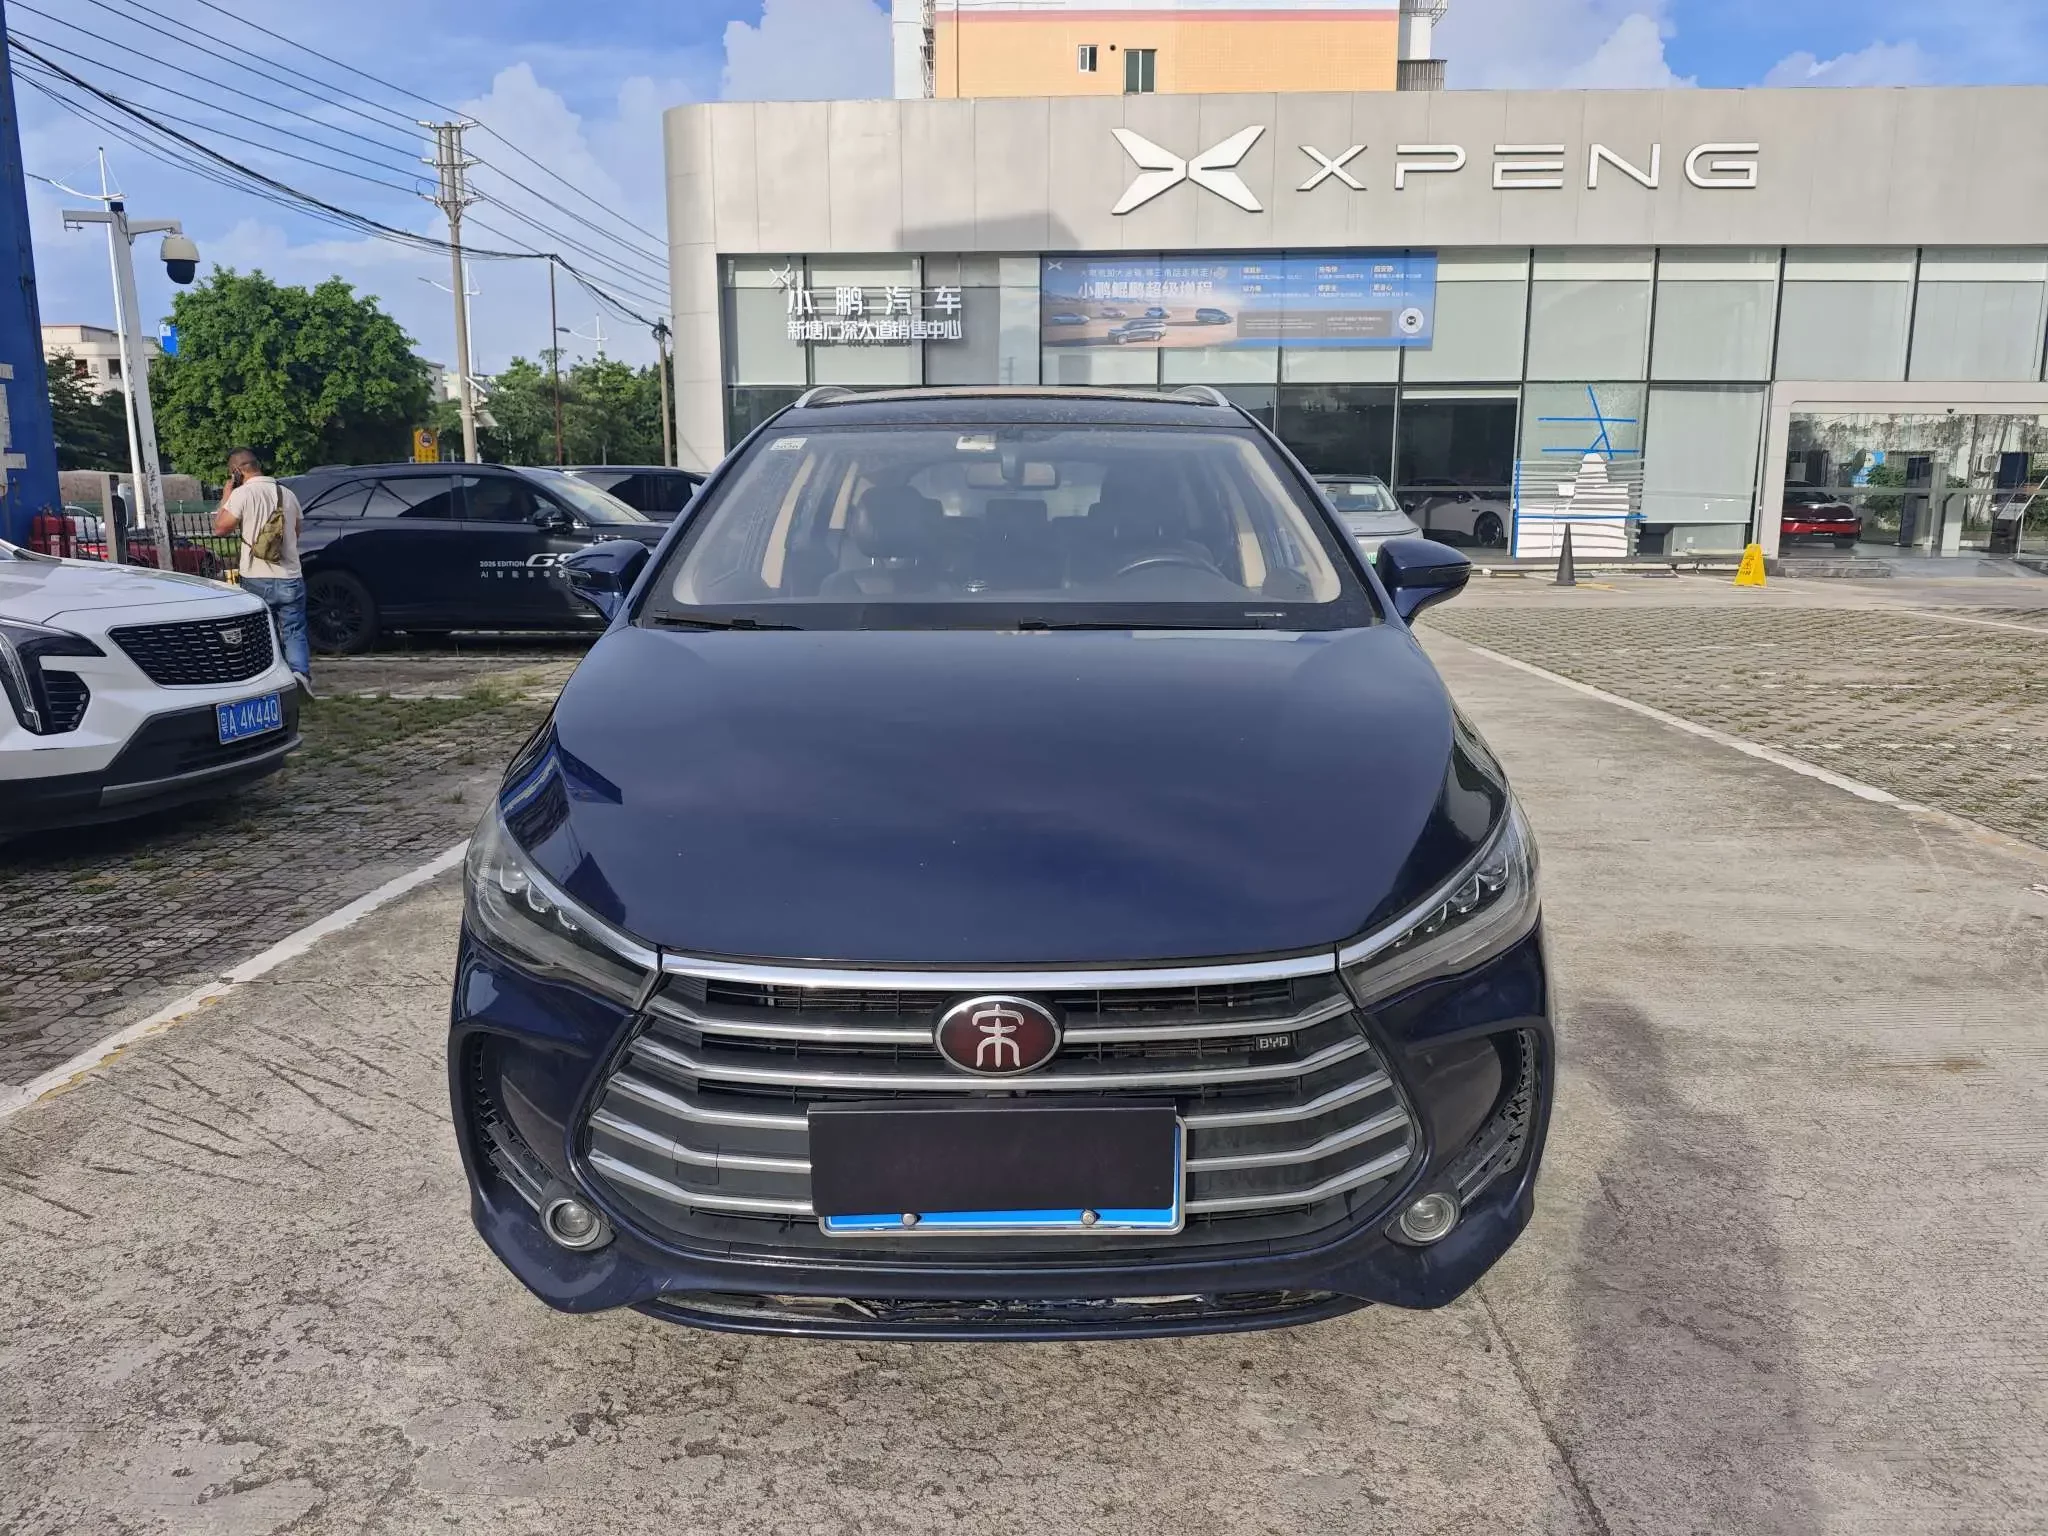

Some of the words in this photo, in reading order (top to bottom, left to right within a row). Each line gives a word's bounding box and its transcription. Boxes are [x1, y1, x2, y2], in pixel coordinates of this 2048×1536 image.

[1296, 142, 1760, 191] XPENG
[787, 286, 962, 316] 小鹏汽车
[787, 320, 963, 340] 新塘广深大道销售中心
[497, 560, 525, 568] EDITION
[526, 553, 575, 568] GS
[1259, 1036, 1289, 1049] BYD
